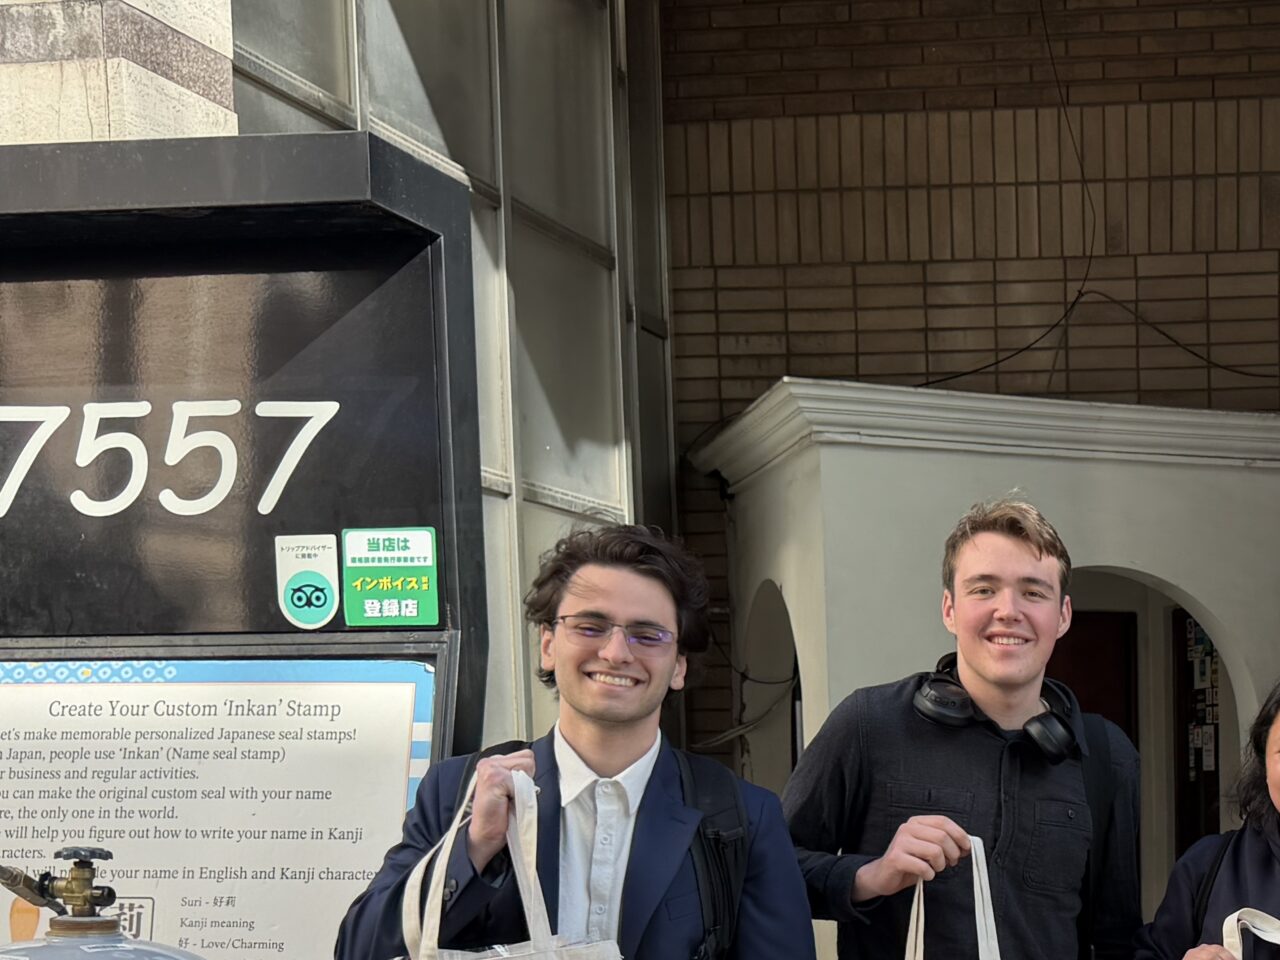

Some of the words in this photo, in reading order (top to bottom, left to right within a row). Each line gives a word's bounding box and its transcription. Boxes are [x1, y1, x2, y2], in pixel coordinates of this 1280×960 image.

[0, 399, 341, 518] 7557
[367, 537, 411, 552] 当店は
[363, 598, 419, 618] 登録店
[49, 700, 103, 717] Create
[108, 700, 149, 717] Your
[153, 700, 218, 717] Custom
[286, 700, 342, 721] Stamp
[0, 728, 20, 741] et's
[23, 728, 57, 741] make
[60, 728, 131, 741] memorable
[134, 728, 214, 744] personalized
[217, 728, 275, 744] Japanese
[278, 728, 303, 741] seal
[307, 728, 357, 744] stamps!
[6, 748, 46, 763] Japan,
[49, 747, 91, 763] people
[94, 751, 116, 760] use
[166, 748, 210, 762] (Name
[212, 748, 237, 760] seal
[240, 748, 286, 763] stamp)
[8, 767, 61, 780] business
[64, 767, 88, 780] and
[91, 768, 137, 783] regular
[139, 768, 199, 780] activities.
[12, 789, 35, 799] can
[38, 787, 72, 799] make
[76, 787, 96, 799] the
[99, 787, 148, 802] original
[151, 788, 197, 800] custom
[201, 787, 225, 800] seal
[229, 787, 258, 800] with
[261, 790, 292, 803] your
[295, 790, 332, 800] name
[18, 806, 37, 819] the
[41, 806, 68, 823] only
[71, 809, 95, 820] one
[99, 806, 111, 819] in
[115, 806, 135, 820] the
[138, 806, 179, 820] world.
[5, 826, 28, 839] will
[31, 826, 59, 842] help
[61, 829, 85, 842] you
[88, 826, 126, 842] figure
[128, 828, 150, 839] out
[153, 826, 182, 839] how
[185, 828, 198, 839] to
[200, 827, 234, 840] write
[237, 829, 267, 843] your
[270, 829, 307, 840] name
[311, 827, 323, 840] in
[327, 827, 363, 844] Kanji
[111, 868, 141, 882] your
[143, 869, 179, 880] name
[182, 867, 194, 880] in
[199, 867, 247, 883] English
[251, 867, 276, 880] and
[280, 868, 315, 884] Kanji
[181, 896, 203, 907] Suri
[180, 917, 207, 930] Kanji
[210, 919, 255, 930] meaning
[201, 938, 285, 952] Love/Charming
